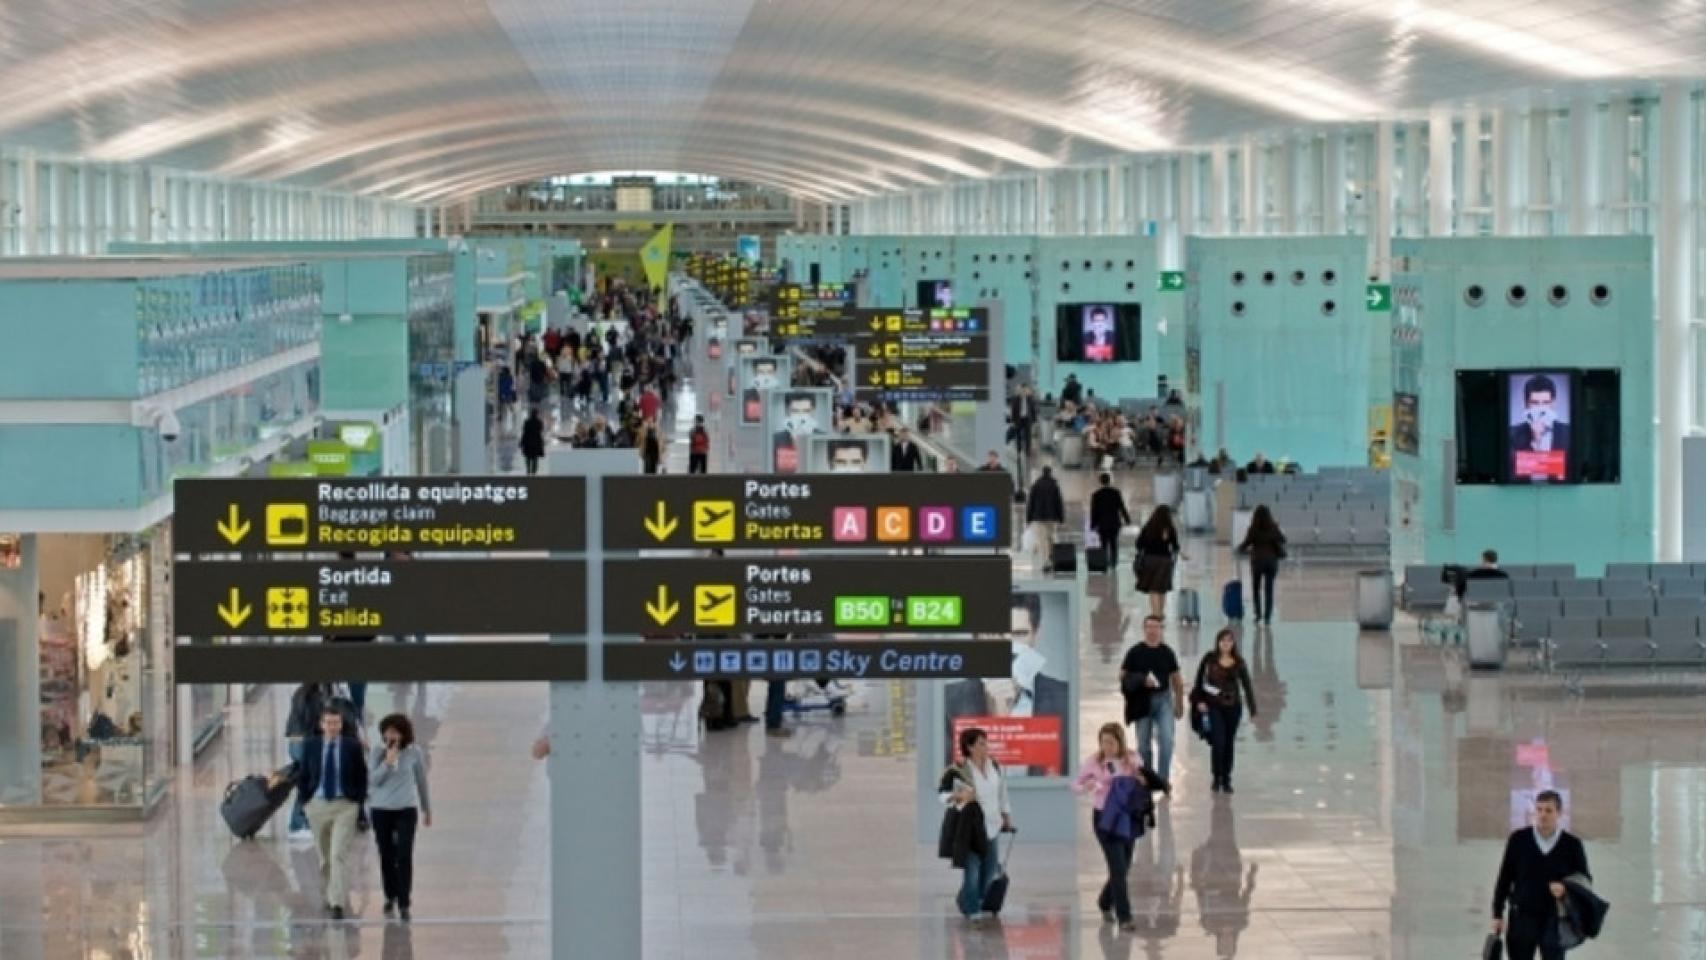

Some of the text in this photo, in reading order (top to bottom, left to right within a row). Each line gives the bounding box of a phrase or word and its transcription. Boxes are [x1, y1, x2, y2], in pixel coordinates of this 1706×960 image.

[318, 482, 529, 505] Recollida equipatges
[746, 480, 811, 498] Portes
[318, 504, 436, 524] Baggage claim
[746, 502, 790, 517] Gates
[746, 522, 823, 540] Puertas
[842, 511, 987, 536] A C D E
[318, 524, 515, 546] Recogida equipajes
[318, 566, 392, 585] Sortida
[746, 564, 811, 583] Portes
[318, 588, 348, 605] Exit
[746, 586, 790, 603] Gates
[318, 608, 381, 627] Salida
[746, 606, 823, 624] Puertas
[840, 601, 885, 621] B50
[912, 601, 955, 621] B24
[826, 649, 963, 675] Sky Centre
